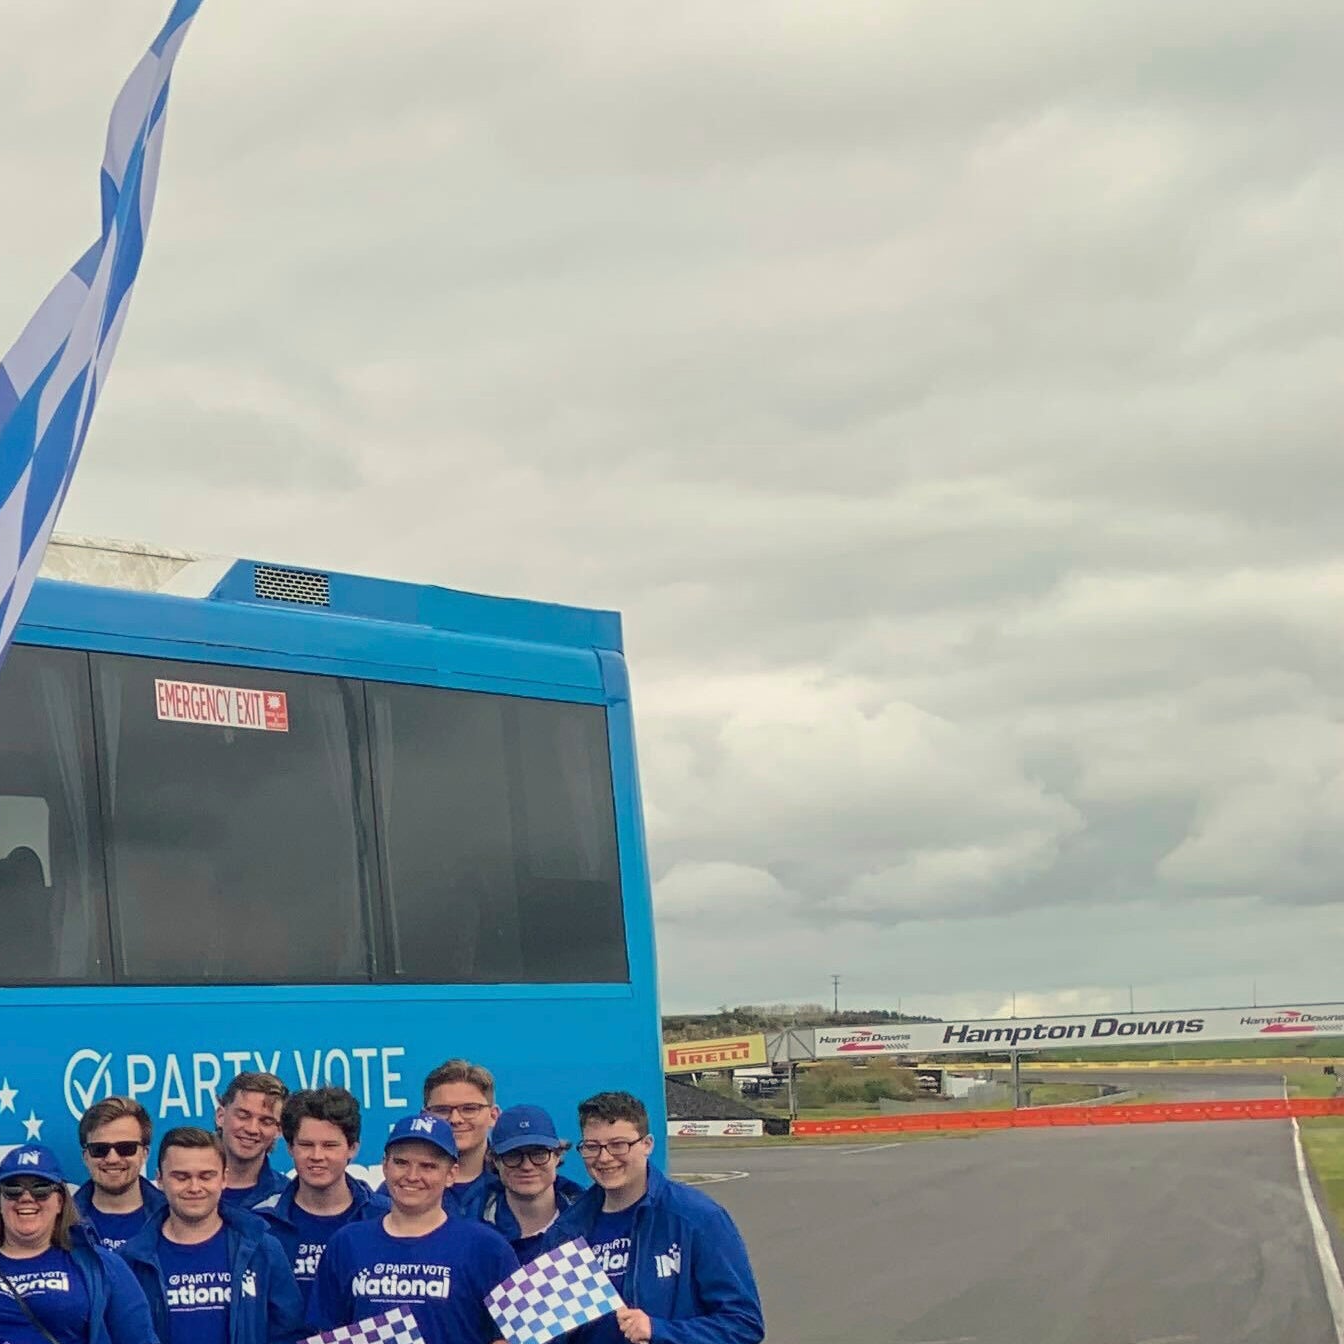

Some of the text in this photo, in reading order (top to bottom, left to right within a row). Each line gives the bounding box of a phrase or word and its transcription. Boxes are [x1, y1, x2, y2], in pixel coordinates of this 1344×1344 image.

[157, 682, 231, 723] EMERGENCY
[235, 691, 261, 726] EXIT
[942, 1018, 1204, 1047] Hampton Downs
[668, 1042, 749, 1067] PIRELLI
[294, 1047, 408, 1109] VOTE
[181, 1272, 231, 1284] PARTY VO
[386, 1263, 451, 1277] PARTY VOTE
[166, 1281, 232, 1305] ationa
[352, 1274, 451, 1299] National
